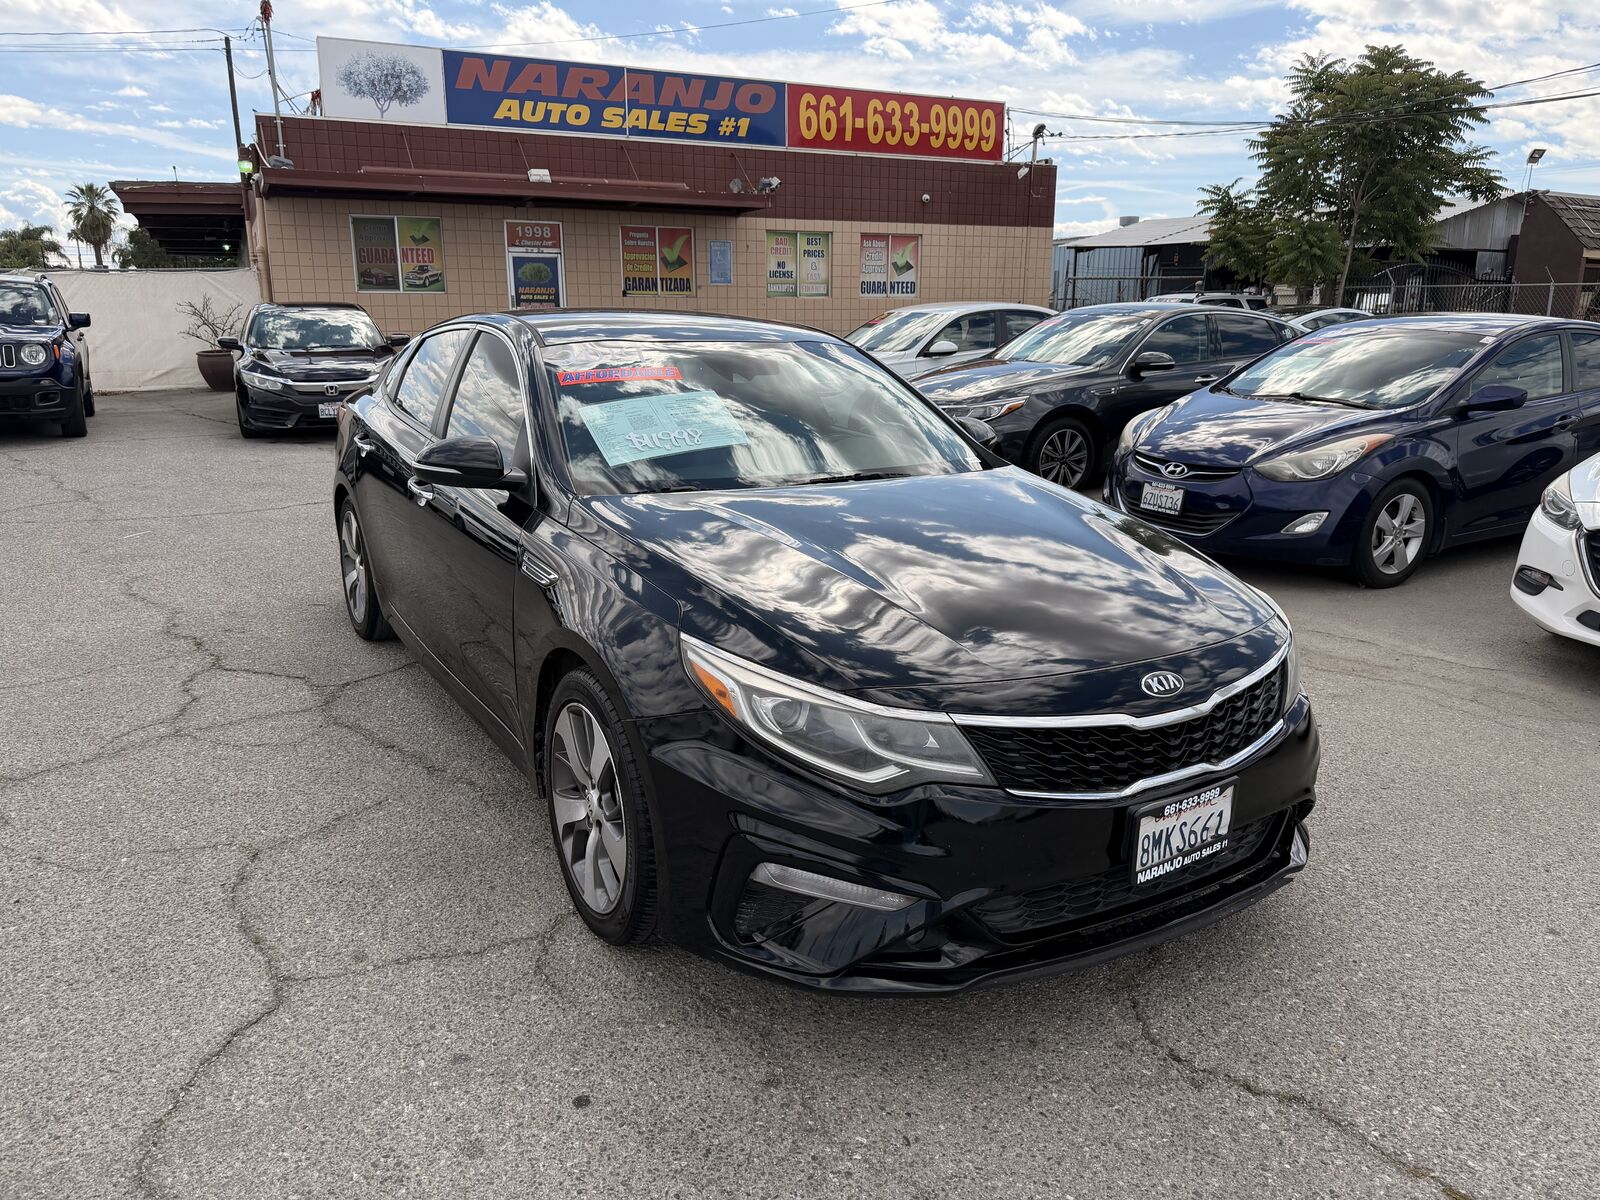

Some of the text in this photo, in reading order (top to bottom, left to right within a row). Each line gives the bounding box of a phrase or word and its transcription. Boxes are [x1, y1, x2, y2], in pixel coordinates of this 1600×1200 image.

[454, 57, 777, 114] NARANJO
[493, 98, 750, 137] AUTO SALES #1
[799, 92, 996, 152] 661-633-9999
[515, 225, 552, 239] 1998
[775, 237, 788, 246] BAD
[806, 237, 822, 246] BEST
[863, 239, 872, 248] Ask
[358, 247, 435, 265] GUARANTEED
[770, 247, 792, 256] CREDIT
[803, 249, 825, 258] PRICES
[865, 250, 883, 261] Credit
[776, 260, 786, 270] NO
[810, 261, 818, 271] &
[769, 270, 794, 279] LICENSE
[624, 276, 692, 293] GARANTIZADA
[860, 280, 916, 295] GUARANTEED
[562, 366, 676, 383] AFFORDABLE
[1147, 674, 1181, 693] KIA
[1164, 787, 1221, 817] 661-633-9999
[1139, 808, 1225, 868] 8MKS661
[1136, 856, 1183, 885] NARANJO
[1183, 851, 1201, 866] AUTO
[1201, 841, 1222, 858] SALES
